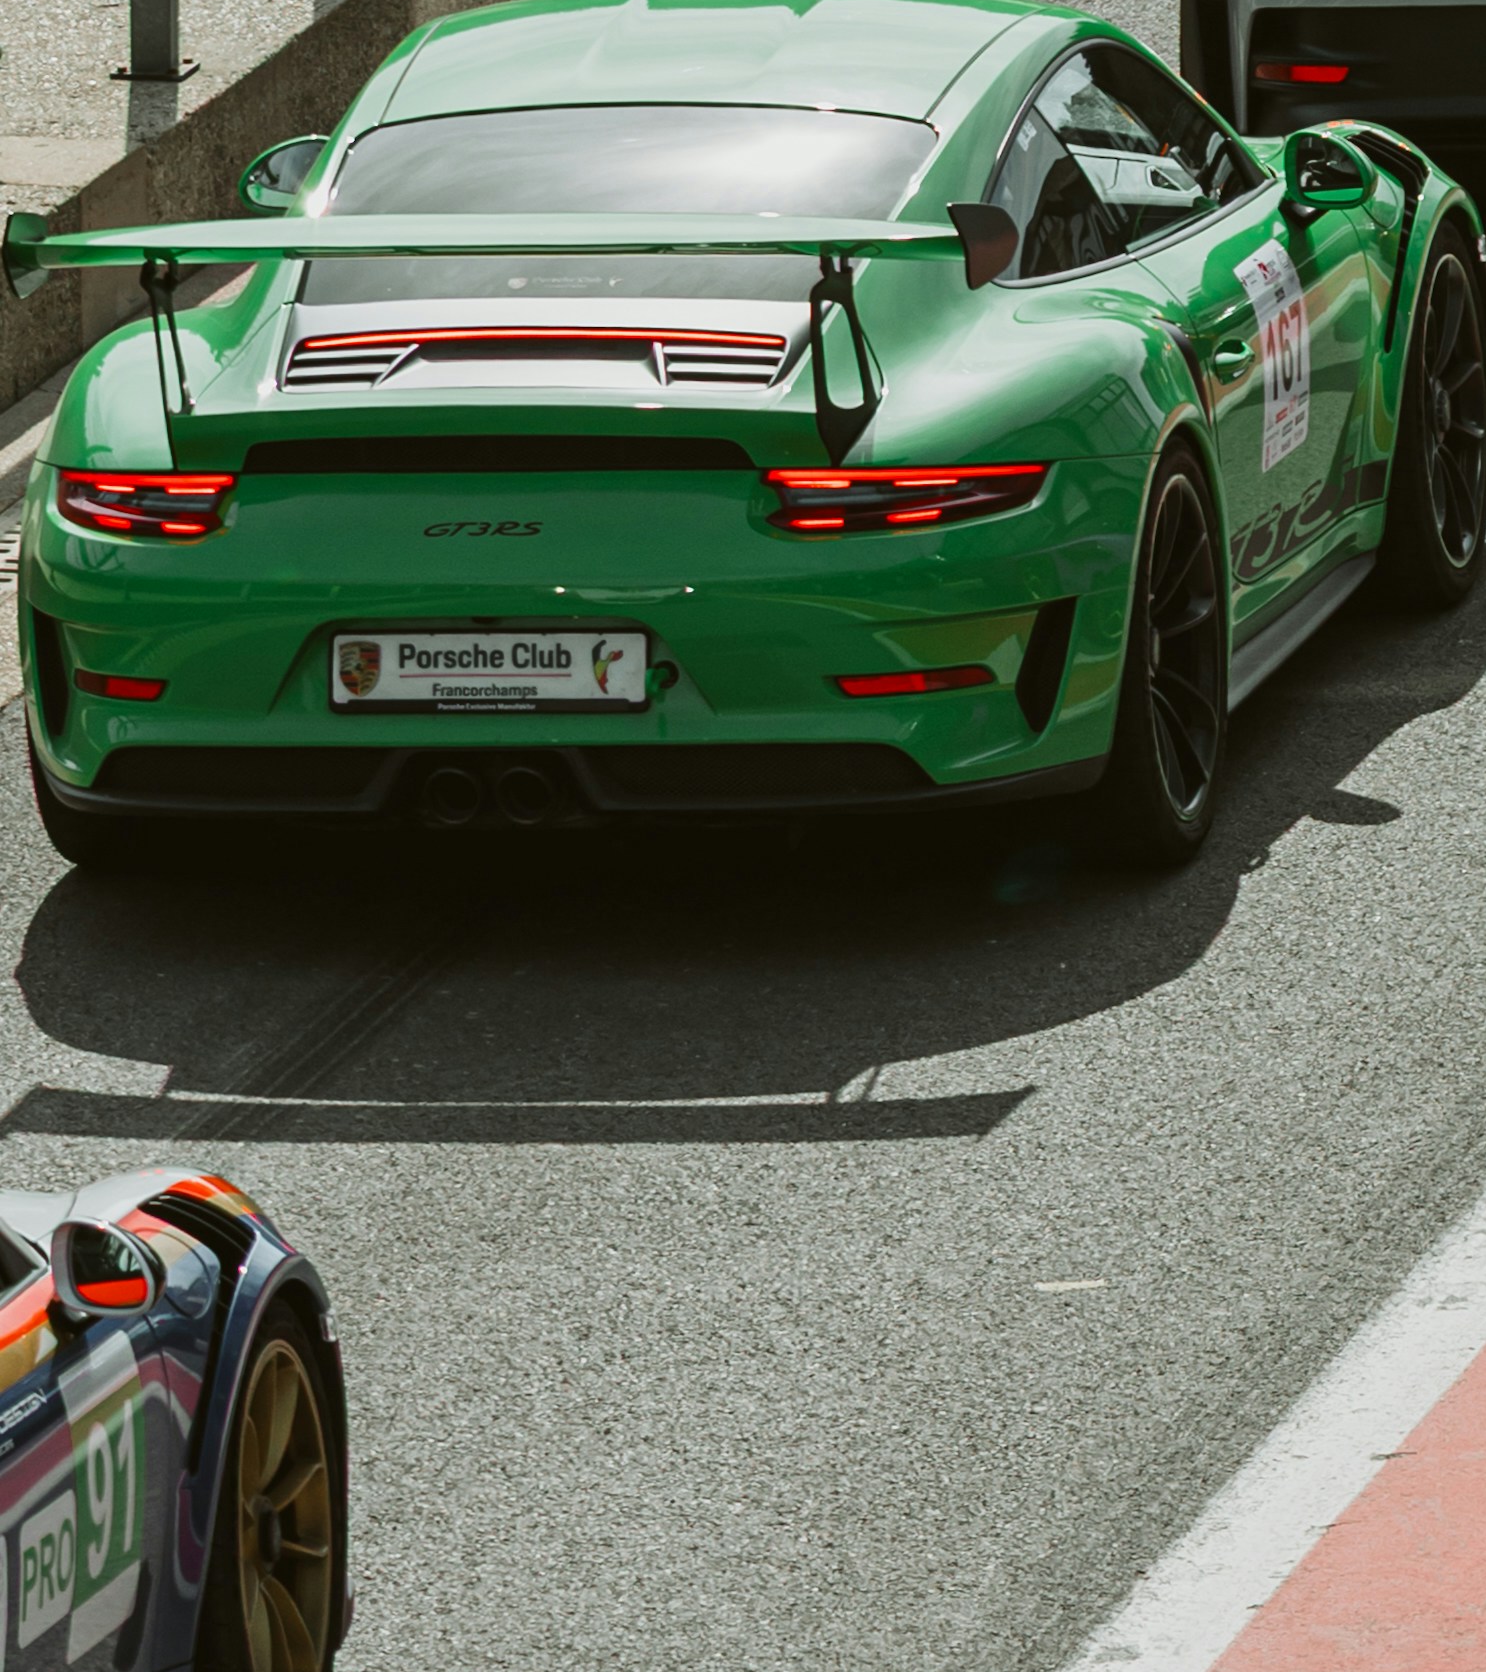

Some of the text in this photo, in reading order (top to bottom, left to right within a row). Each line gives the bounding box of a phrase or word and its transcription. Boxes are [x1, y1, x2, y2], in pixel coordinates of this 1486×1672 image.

[1267, 302, 1303, 401] 167
[398, 642, 572, 669] Porsche Club
[432, 683, 538, 699] Francorchamps
[437, 702, 465, 710] Porsche
[87, 1398, 136, 1579] 91
[22, 1518, 75, 1623] PRO
